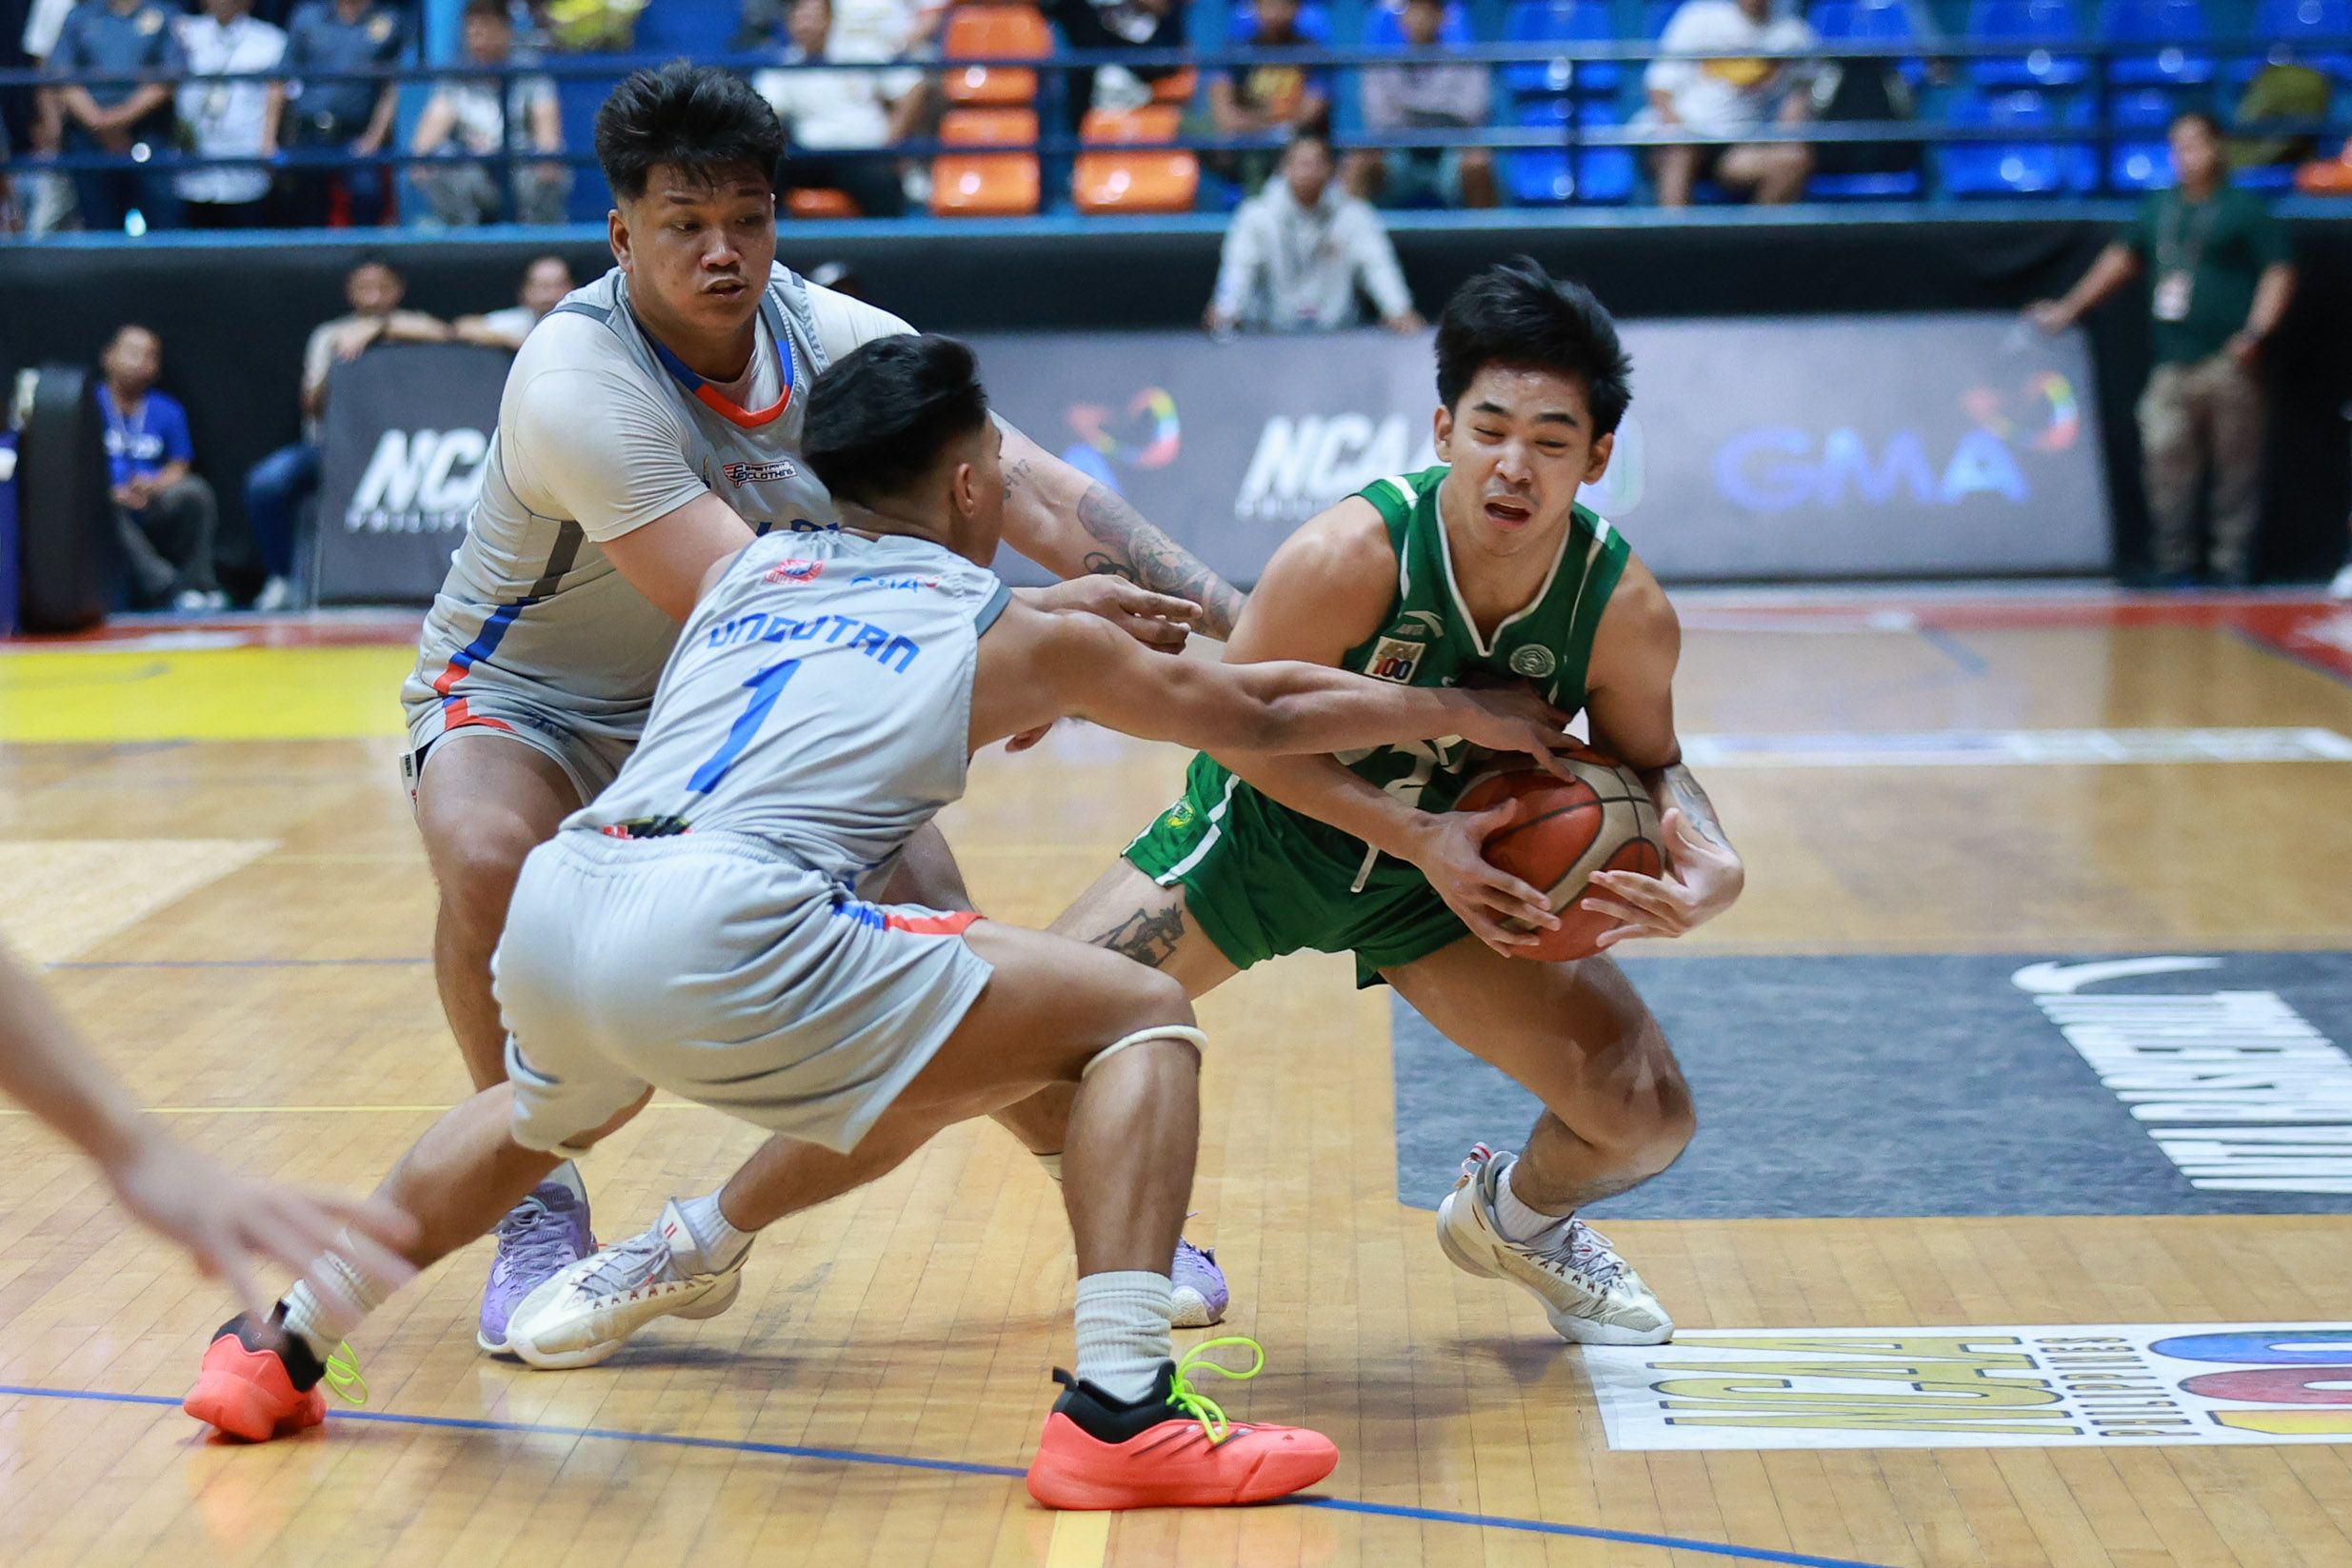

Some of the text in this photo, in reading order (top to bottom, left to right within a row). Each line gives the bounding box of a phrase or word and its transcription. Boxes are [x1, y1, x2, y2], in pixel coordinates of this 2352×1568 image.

[349, 427, 488, 513] NC
[1712, 427, 2032, 511] GMA
[1373, 654, 1412, 680] 100
[686, 658, 801, 795] 1
[1646, 1335, 2085, 1436] NCAA
[2033, 1336, 2202, 1439] PHILIPPINES
